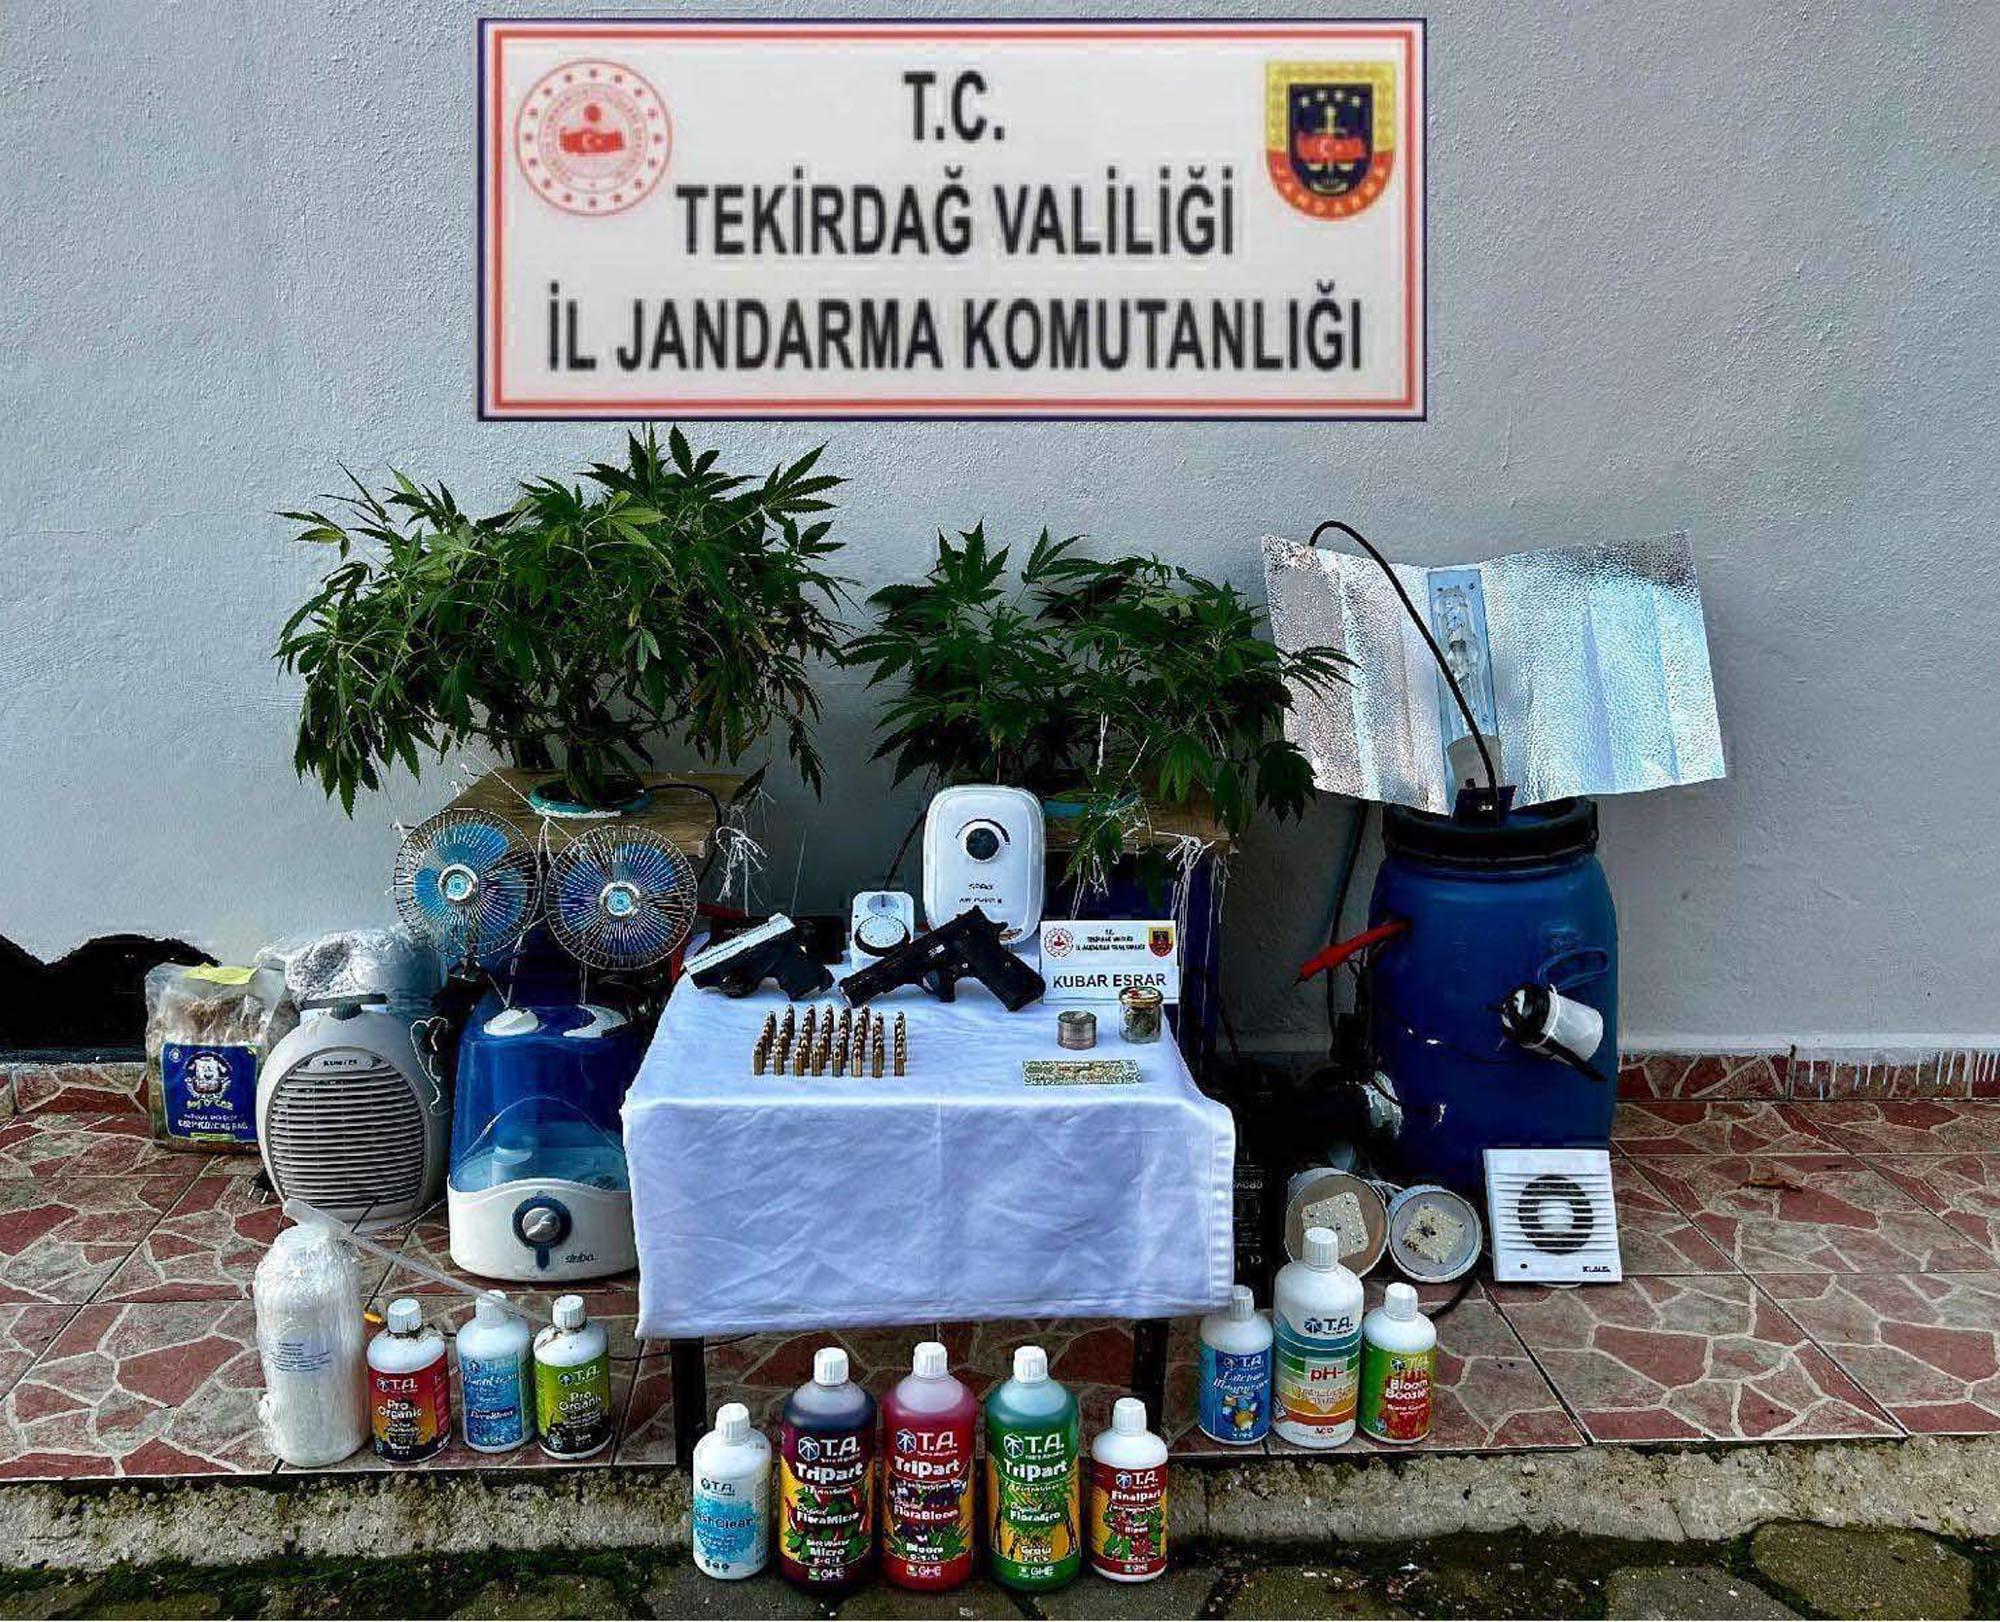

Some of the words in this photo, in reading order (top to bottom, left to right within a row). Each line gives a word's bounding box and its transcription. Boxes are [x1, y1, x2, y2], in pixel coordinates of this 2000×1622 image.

[1053, 974, 1108, 988] KUBAR
[1113, 973, 1167, 987] ESRAR
[1323, 1316, 1354, 1331] T.A.
[1310, 1366, 1344, 1382] pH-
[1390, 1379, 1429, 1390] Bloom
[387, 1399, 409, 1410] Pro
[570, 1391, 592, 1403] Pro
[377, 1404, 424, 1420] Organic
[821, 1436, 860, 1457] T.A.
[917, 1431, 958, 1451] T.A.
[1024, 1432, 1065, 1454] T.A.
[796, 1461, 863, 1485] TriPart
[894, 1455, 960, 1478] TriPart
[1003, 1458, 1067, 1482] TriPart
[1132, 1470, 1159, 1485] T.A.
[796, 1511, 860, 1525] FloraMicro
[894, 1504, 960, 1521] FloraBloom
[810, 1547, 845, 1557] Micro
[906, 1542, 943, 1554] Bloom
[1021, 1545, 1052, 1555] Grow
